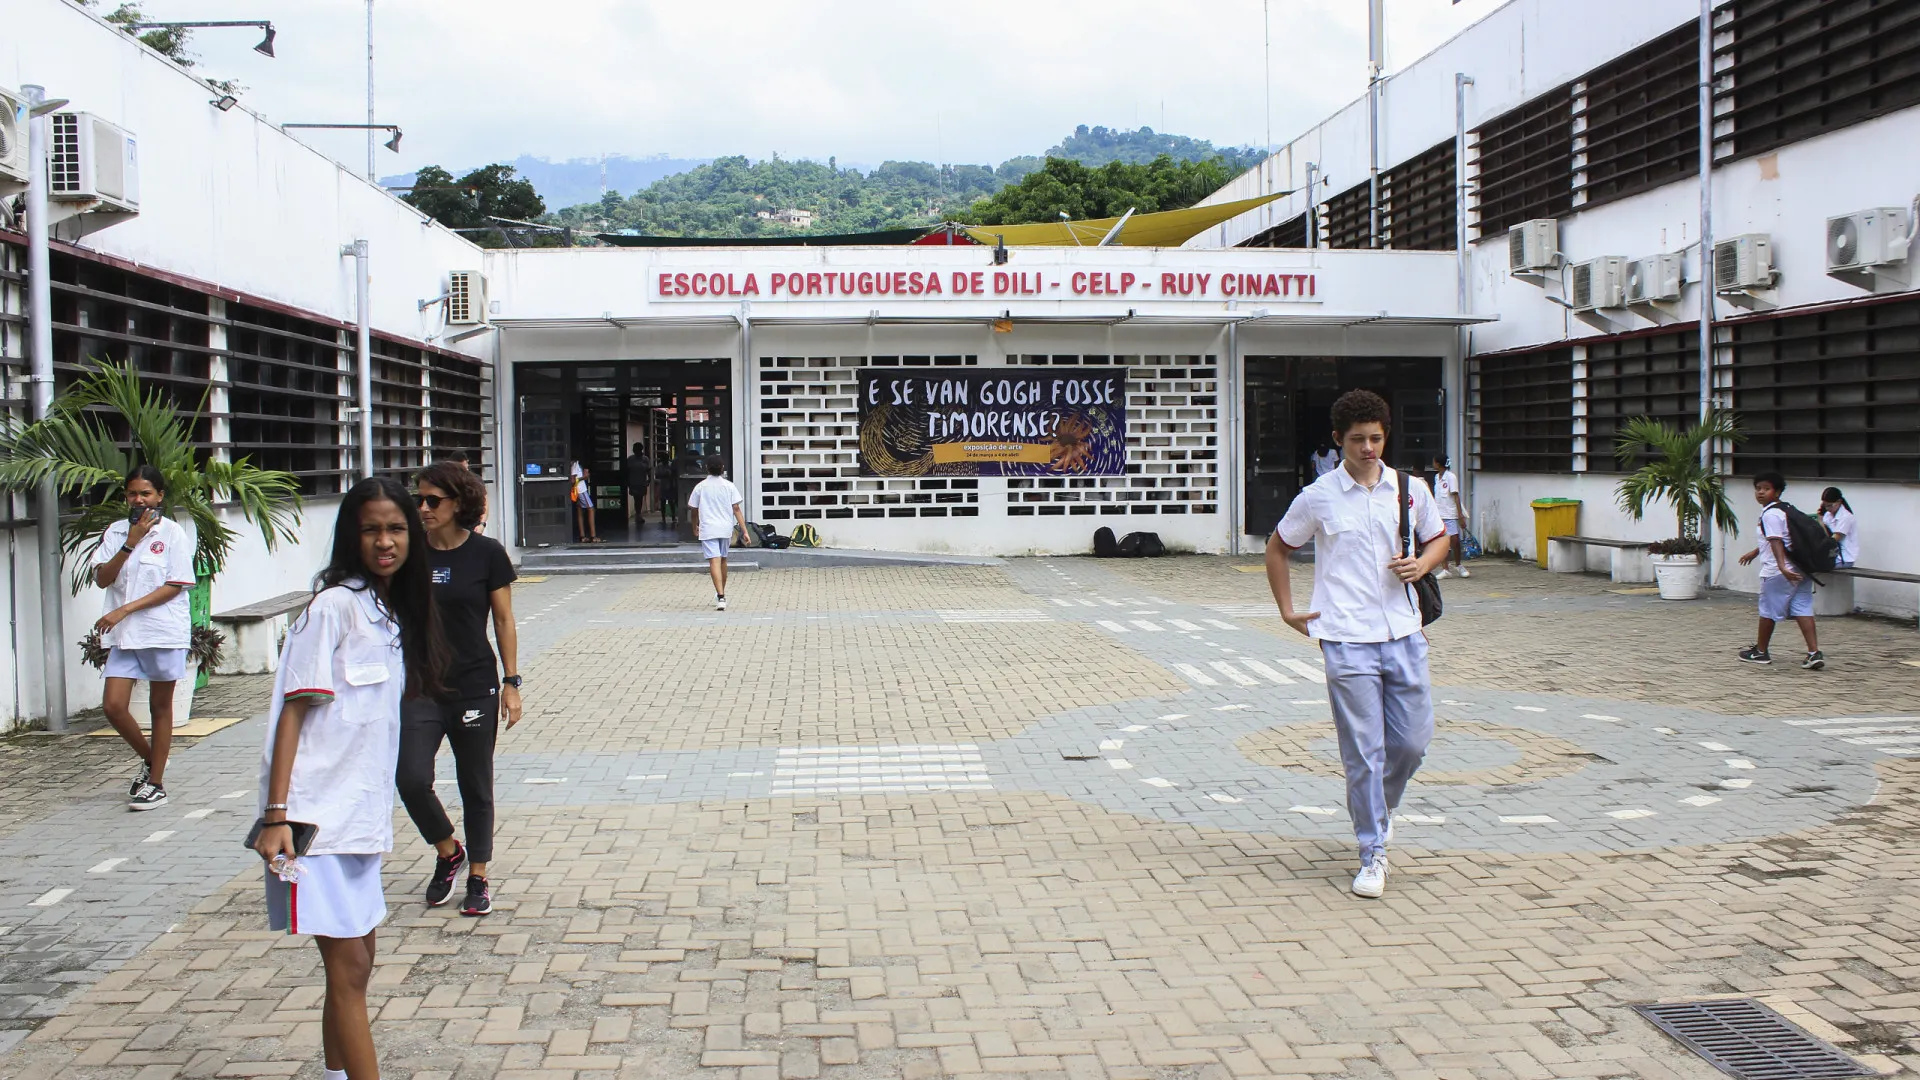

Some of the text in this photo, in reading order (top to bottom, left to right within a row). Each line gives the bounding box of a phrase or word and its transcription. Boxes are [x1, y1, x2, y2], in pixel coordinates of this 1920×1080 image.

[658, 273, 760, 296] ESCOLA
[771, 272, 943, 295] PORTUGUESA
[952, 272, 985, 294] DE
[993, 271, 1042, 294] DILI
[1071, 271, 1136, 294] CELP
[1161, 272, 1211, 295] RUY
[1220, 272, 1316, 296] CINATTI
[868, 378, 1115, 405] E SE VAN GOGH FOSSE
[963, 443, 997, 451] exposição
